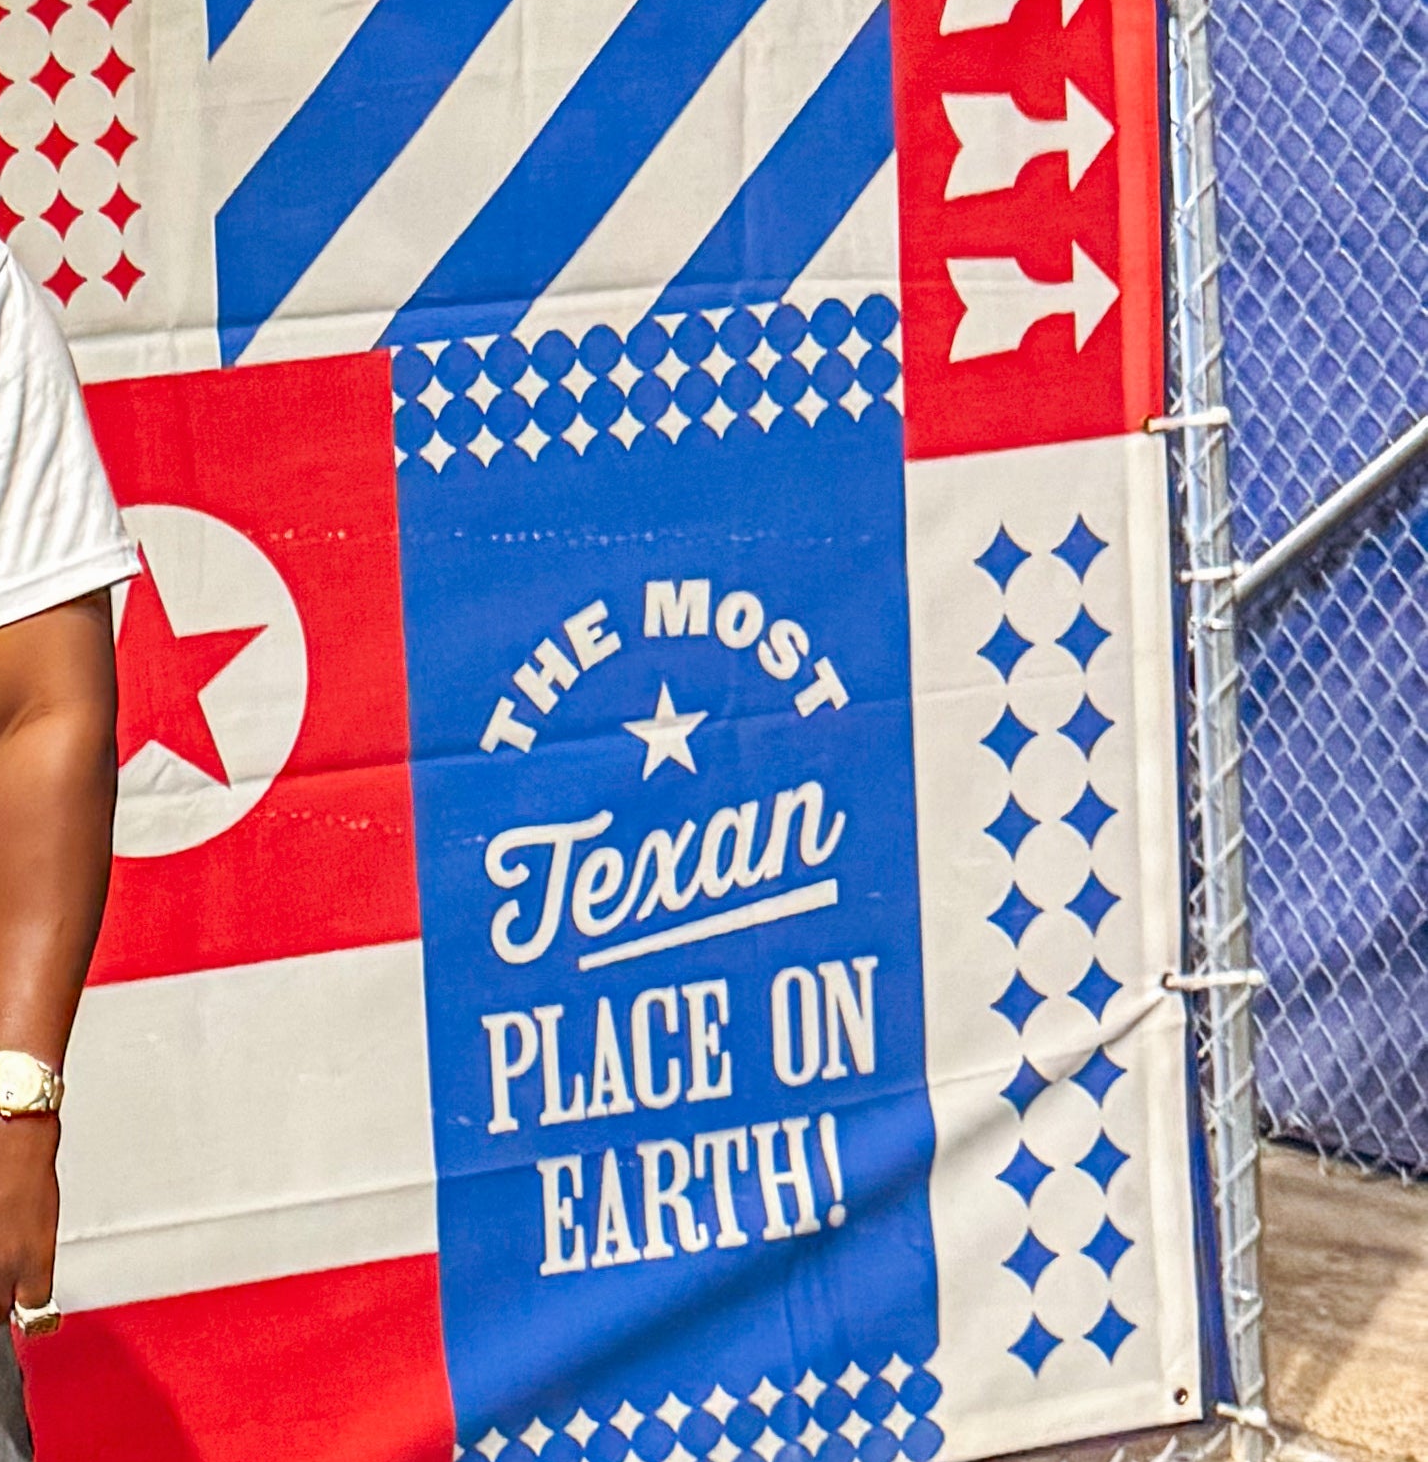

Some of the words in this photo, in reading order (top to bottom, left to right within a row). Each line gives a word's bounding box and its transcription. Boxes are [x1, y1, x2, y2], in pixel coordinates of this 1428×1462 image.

[480, 599, 621, 754] THE
[644, 578, 849, 719] MOST
[485, 780, 846, 965] Texan
[481, 979, 732, 1134] PLACE
[771, 955, 879, 1088] ON
[538, 1113, 847, 1276] EARTH!
